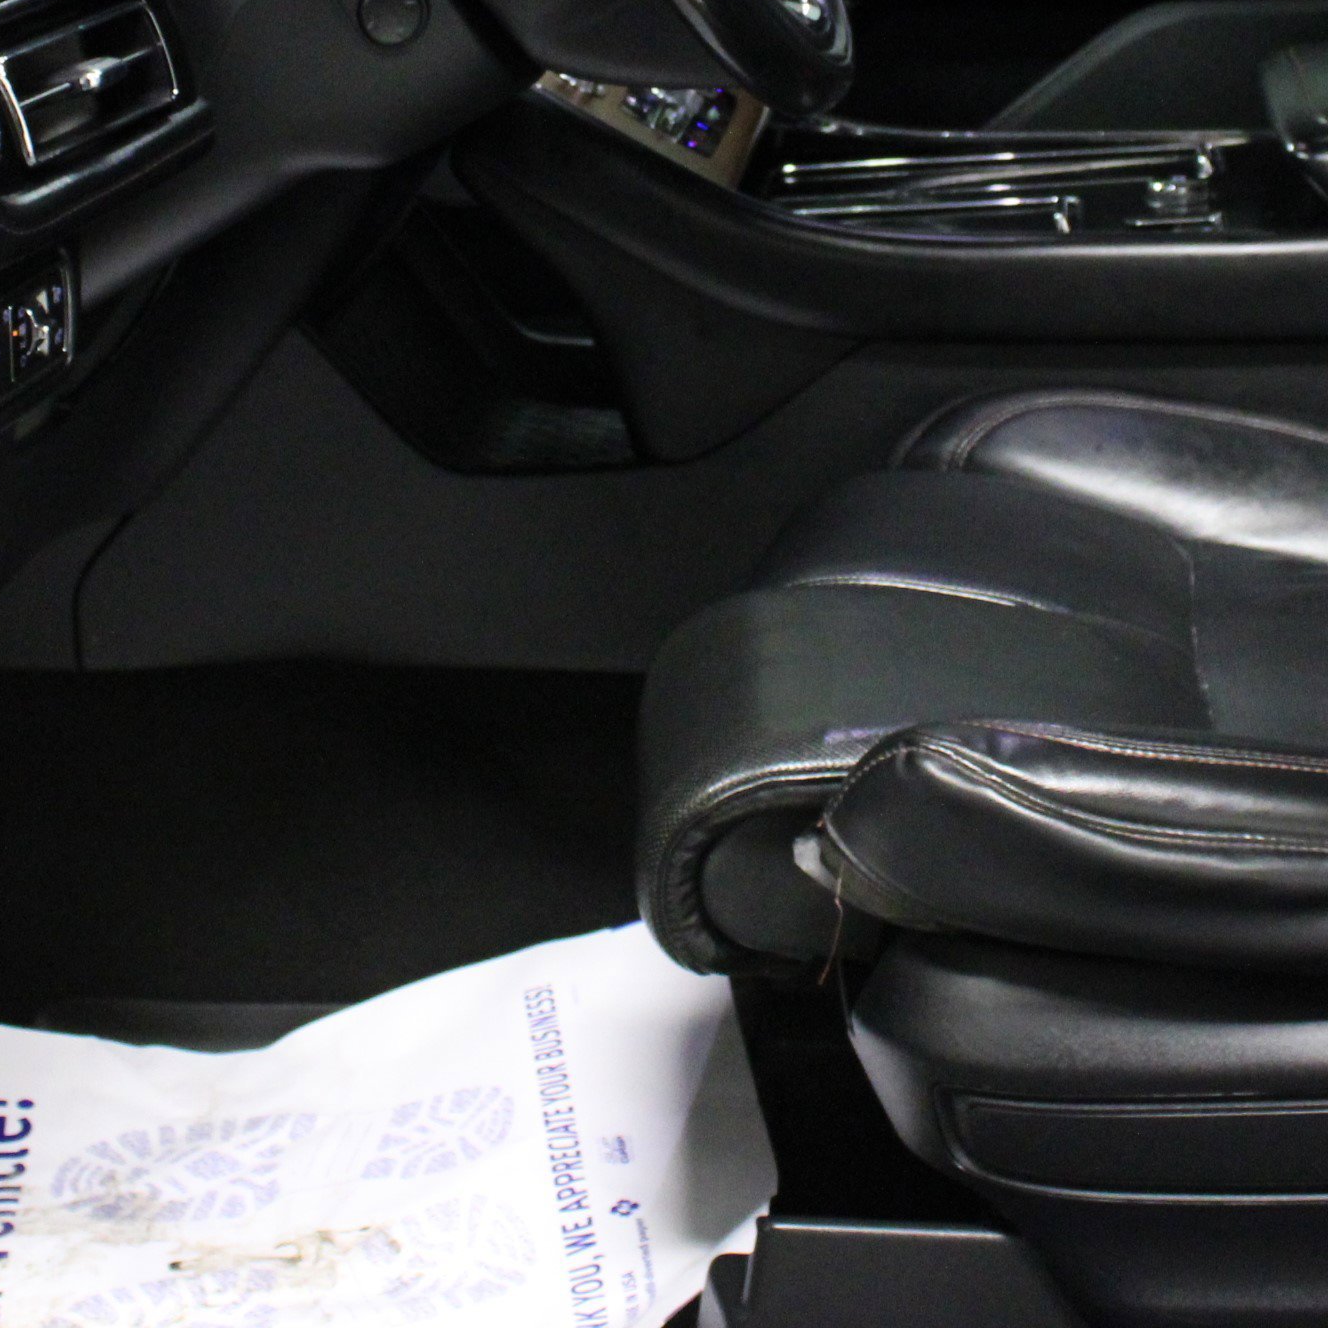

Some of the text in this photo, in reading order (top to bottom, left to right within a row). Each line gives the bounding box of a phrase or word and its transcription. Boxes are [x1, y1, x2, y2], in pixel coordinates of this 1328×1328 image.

[524, 984, 564, 1061] BUSINESS!
[537, 1062, 573, 1107] YOUR
[543, 1106, 590, 1213] APPRECIATE
[561, 1217, 597, 1257] WE
[568, 1254, 605, 1307] YOU,
